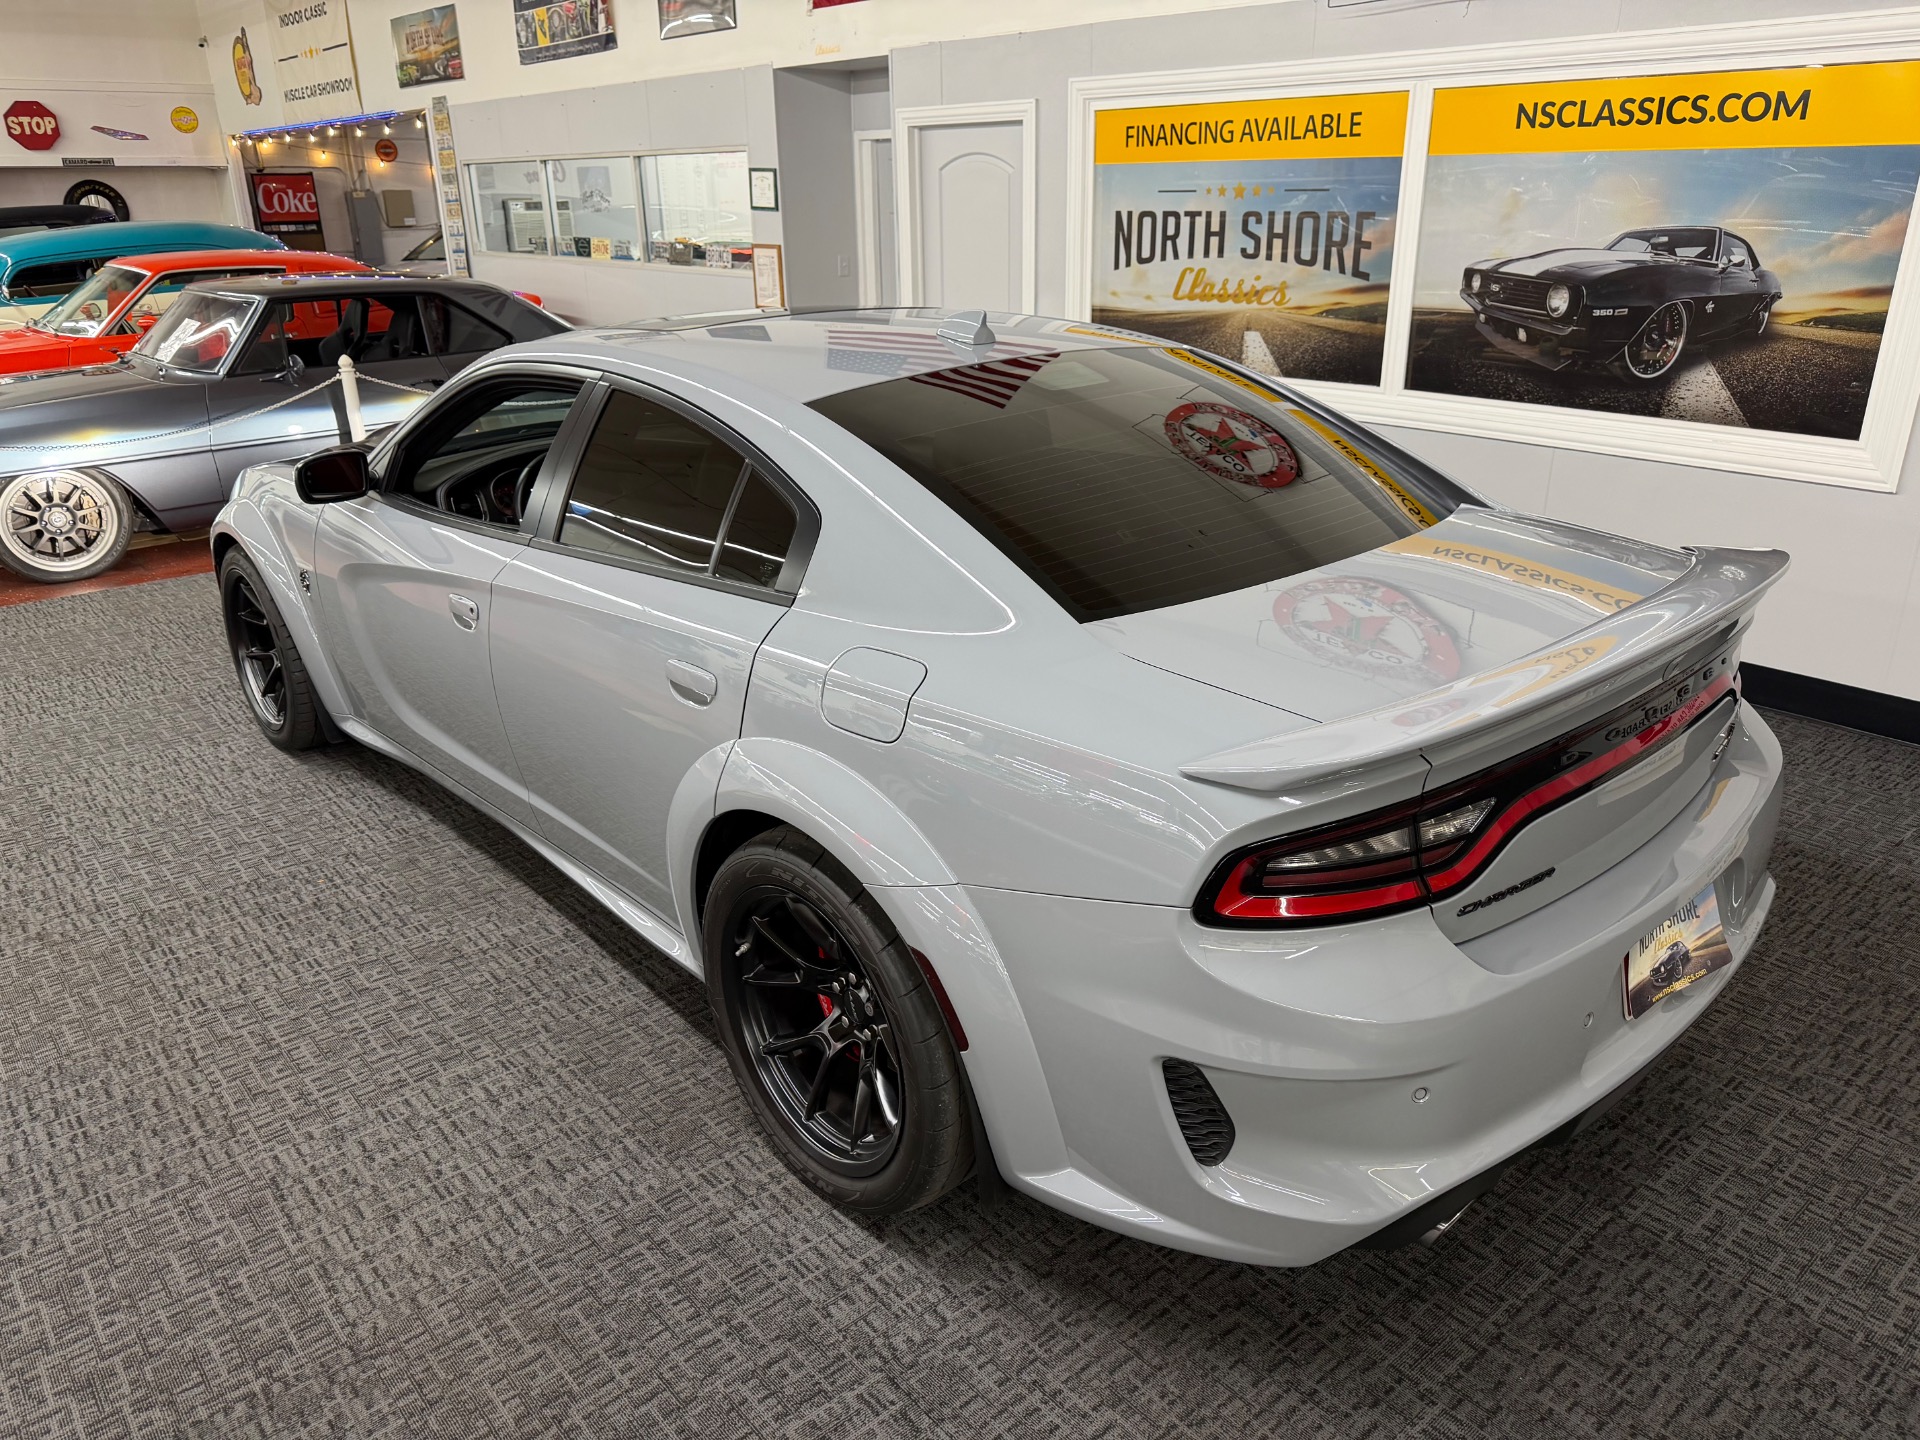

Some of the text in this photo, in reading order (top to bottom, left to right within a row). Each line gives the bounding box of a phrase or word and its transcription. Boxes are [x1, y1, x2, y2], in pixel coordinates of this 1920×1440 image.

[278, 1, 328, 28] INDOOR CLASSIC
[283, 77, 354, 102] MUSCLE CAR SHOWROOM
[1515, 89, 1812, 130] NSCLASSICS.COM
[7, 116, 56, 135] STOP
[1124, 111, 1363, 149] FINANCING AVAILABLE
[257, 183, 318, 214] Coke
[1113, 210, 1377, 282] NORTH SHORE
[1172, 266, 1292, 297] Classics
[1592, 308, 1614, 317] 350
[1456, 866, 1556, 917] CHARGER
[1651, 968, 1708, 1002] www.nsclassics.com
